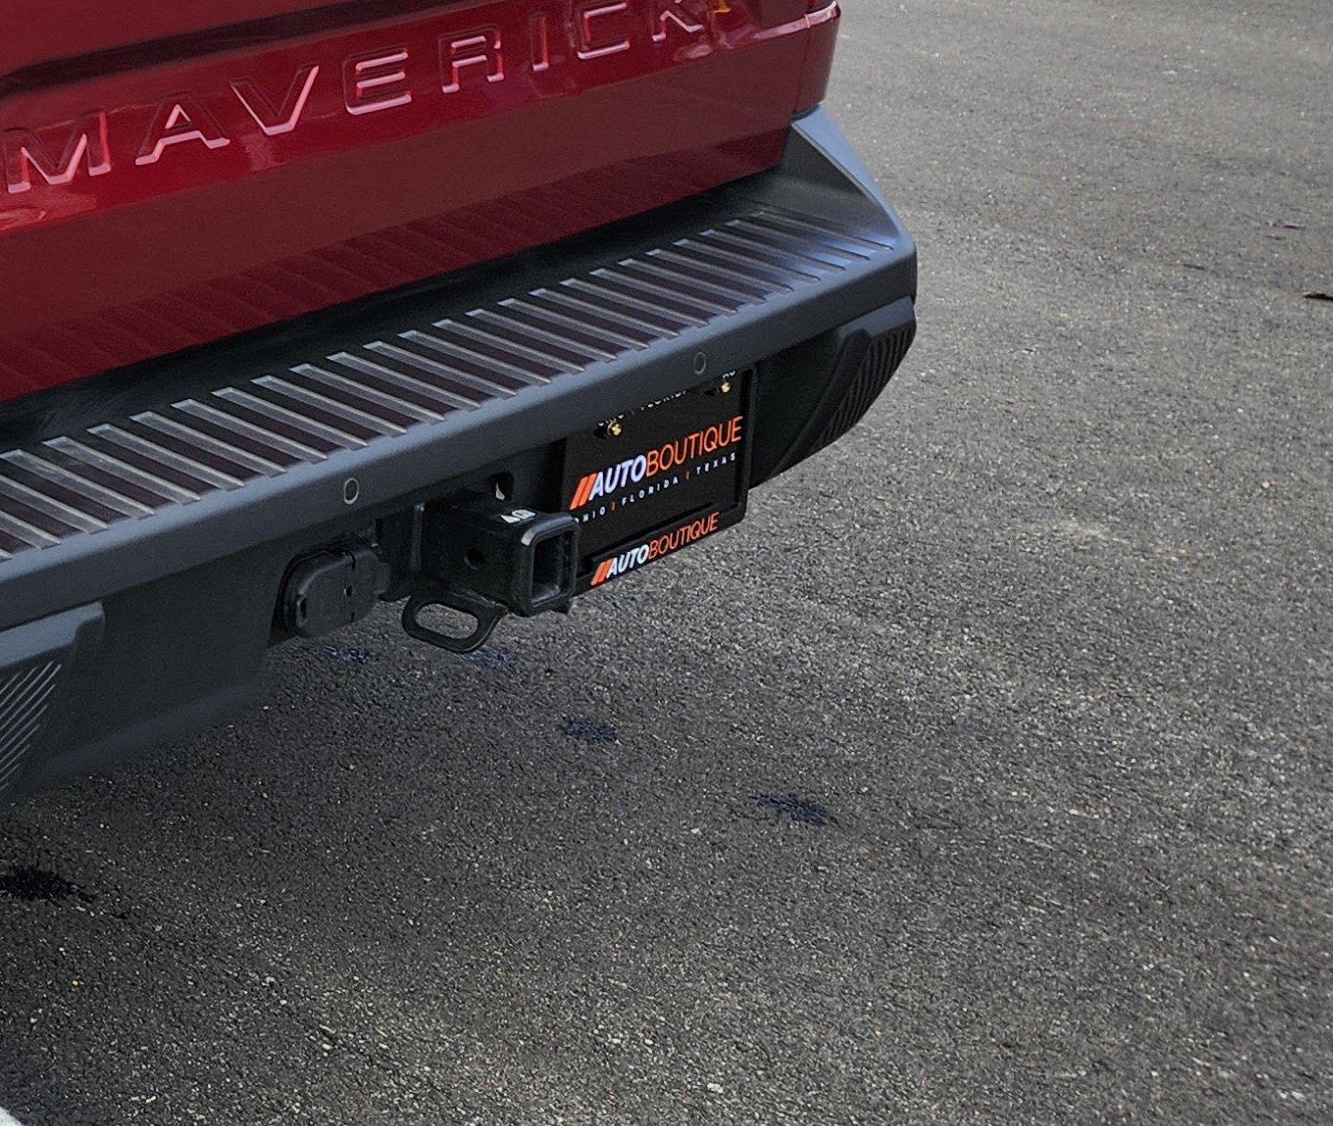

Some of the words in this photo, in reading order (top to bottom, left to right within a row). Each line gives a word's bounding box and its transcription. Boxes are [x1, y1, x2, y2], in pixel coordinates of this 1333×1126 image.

[587, 415, 744, 502] AUTOBOUTIQUE
[621, 476, 679, 506] FLORIDA
[696, 452, 736, 475] TEXAS
[606, 511, 720, 579] AUTOBOUTIQUE
